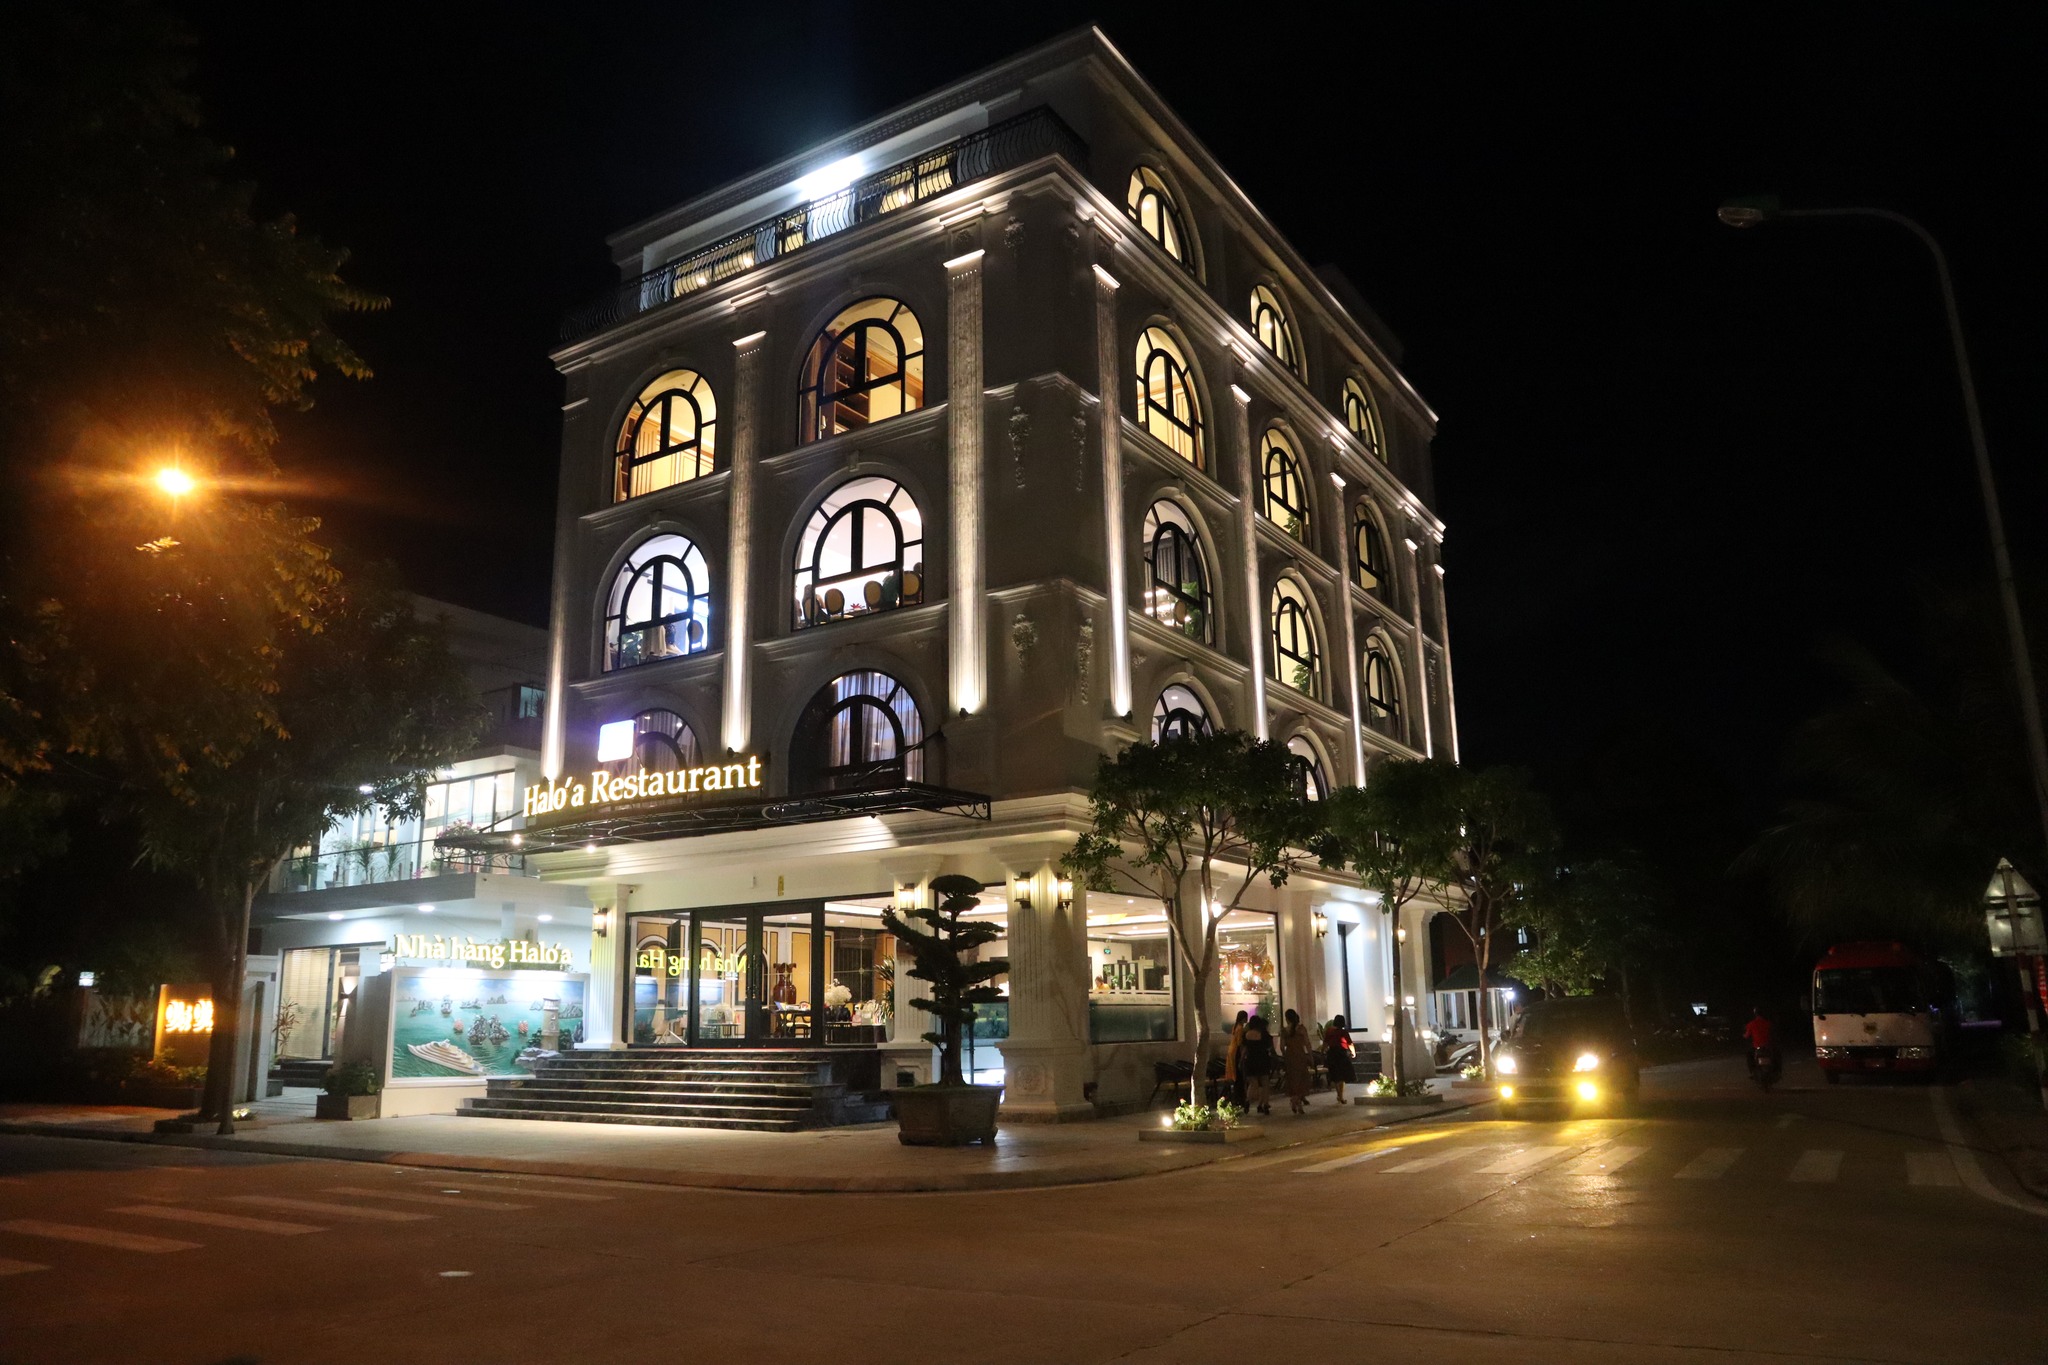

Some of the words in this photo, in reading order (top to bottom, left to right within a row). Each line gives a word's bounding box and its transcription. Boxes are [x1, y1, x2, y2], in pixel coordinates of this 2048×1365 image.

[522, 776, 585, 818] Halo'a
[590, 755, 761, 804] Restaurant
[394, 934, 446, 960] Nhà
[449, 936, 506, 969] hàng
[508, 940, 572, 964] Halo'a
